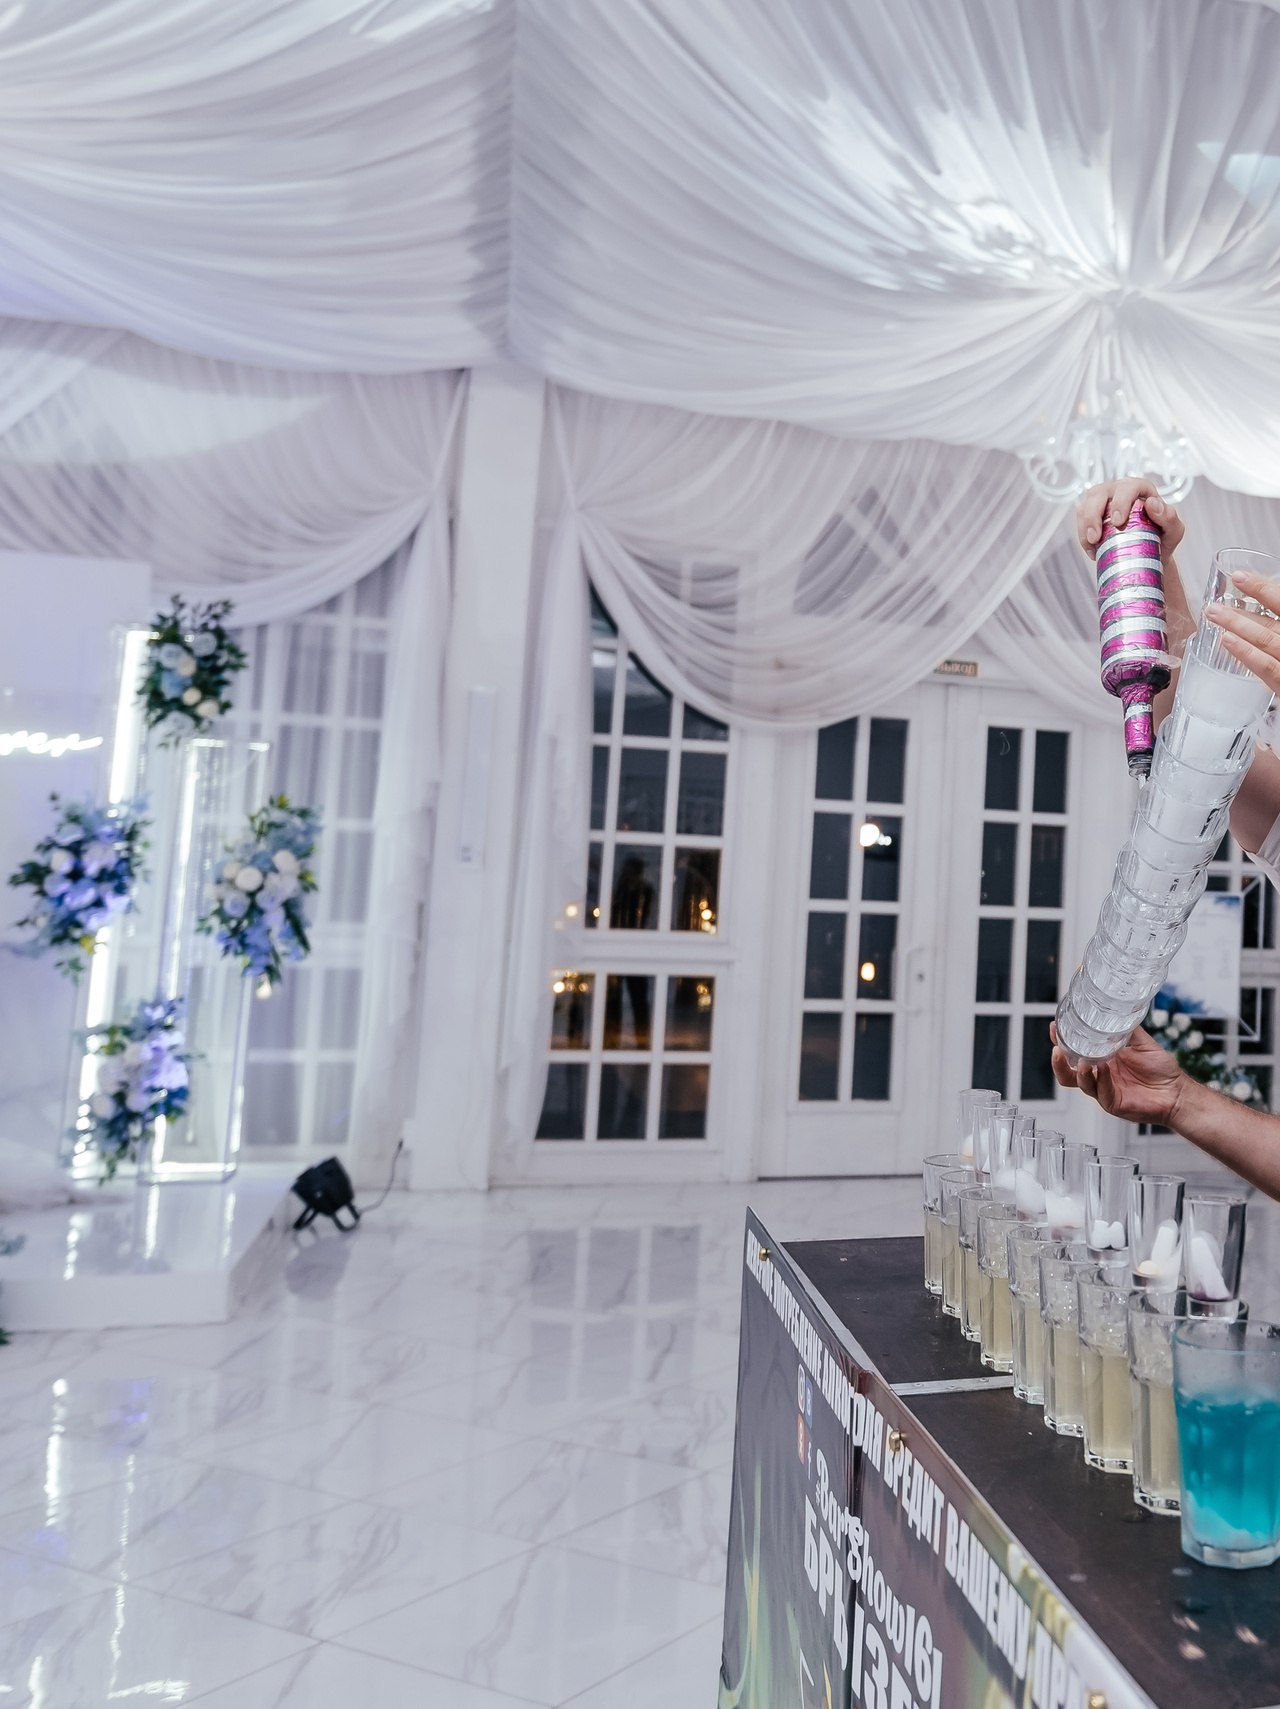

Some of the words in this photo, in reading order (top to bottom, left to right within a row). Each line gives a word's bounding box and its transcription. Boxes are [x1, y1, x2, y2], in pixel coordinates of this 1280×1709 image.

[772, 1266, 823, 1390] УПОТРЕБЛЕНИЕ
[821, 1347, 884, 1473] АЛКОГОЛЯ
[884, 1424, 945, 1556] ВРЕДИТ
[944, 1501, 1031, 1680] ВАШЕМУ
